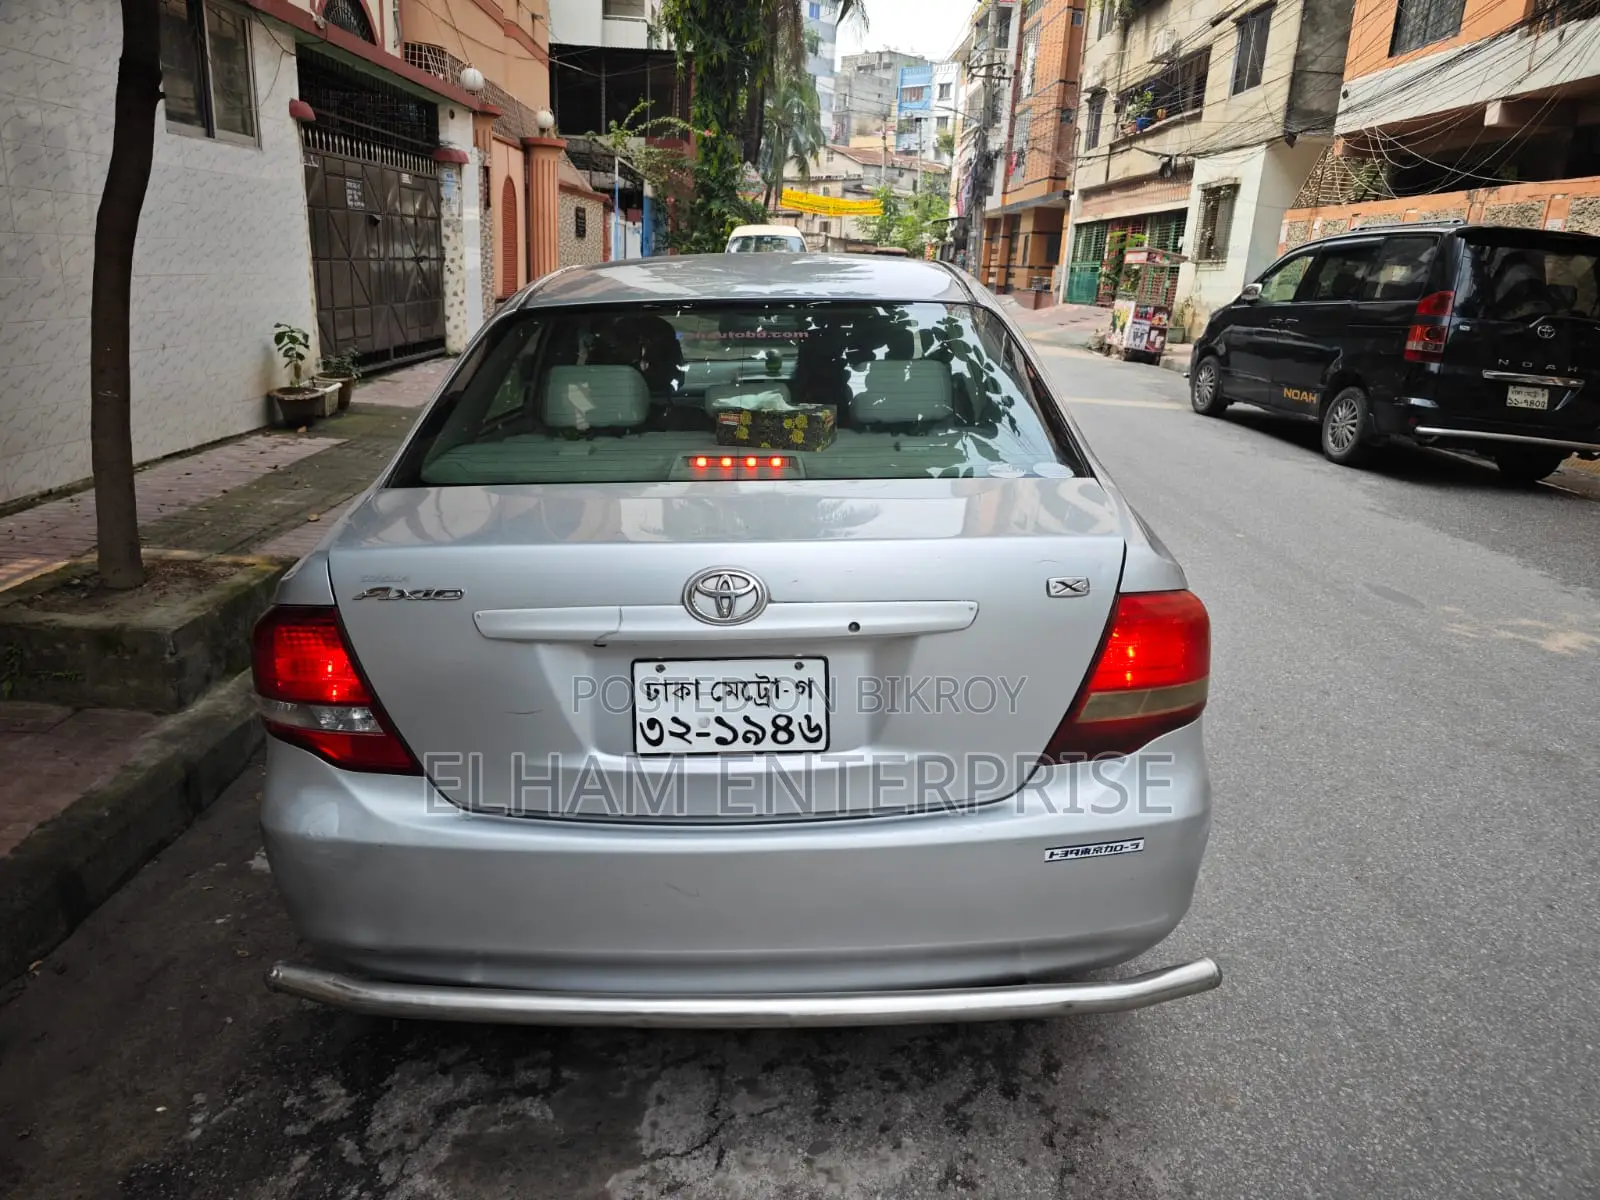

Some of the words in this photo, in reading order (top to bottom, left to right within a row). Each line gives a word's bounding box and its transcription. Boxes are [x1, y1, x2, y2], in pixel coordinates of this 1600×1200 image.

[1498, 359, 1578, 373] NOAH
[1283, 387, 1318, 404] NOAH
[645, 679, 701, 702] ঢাকা
[639, 713, 823, 748] ৩২-১৯৪৬
[1048, 842, 1141, 859] トヨタ東京カローラ
